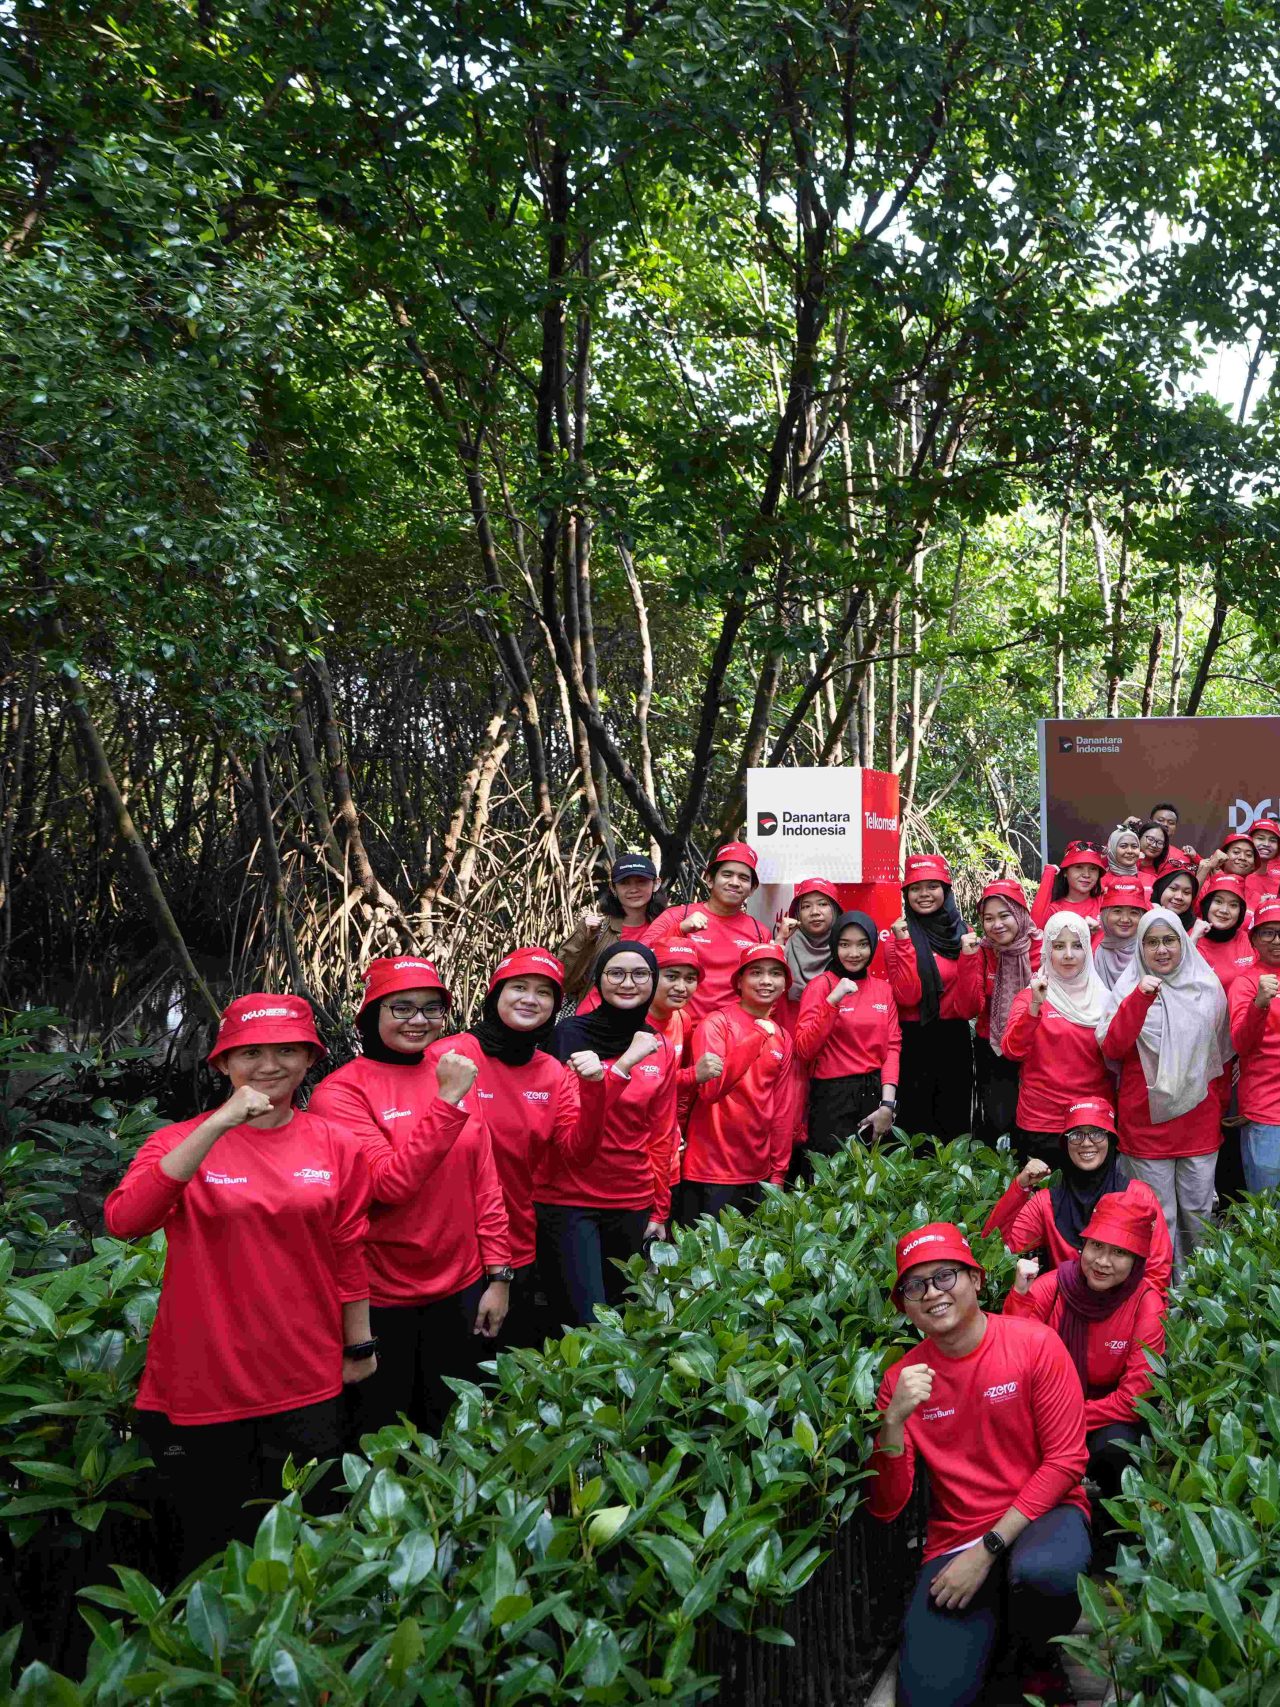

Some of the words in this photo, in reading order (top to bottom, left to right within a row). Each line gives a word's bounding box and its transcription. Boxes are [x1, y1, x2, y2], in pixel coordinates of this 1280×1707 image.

[1076, 736, 1123, 744] Danantara
[1076, 745, 1120, 753] Indonesia
[782, 811, 850, 823] Danantara
[865, 811, 898, 832] Telkomsel
[783, 824, 846, 836] Indonesia
[937, 1408, 955, 1418] Bumi
